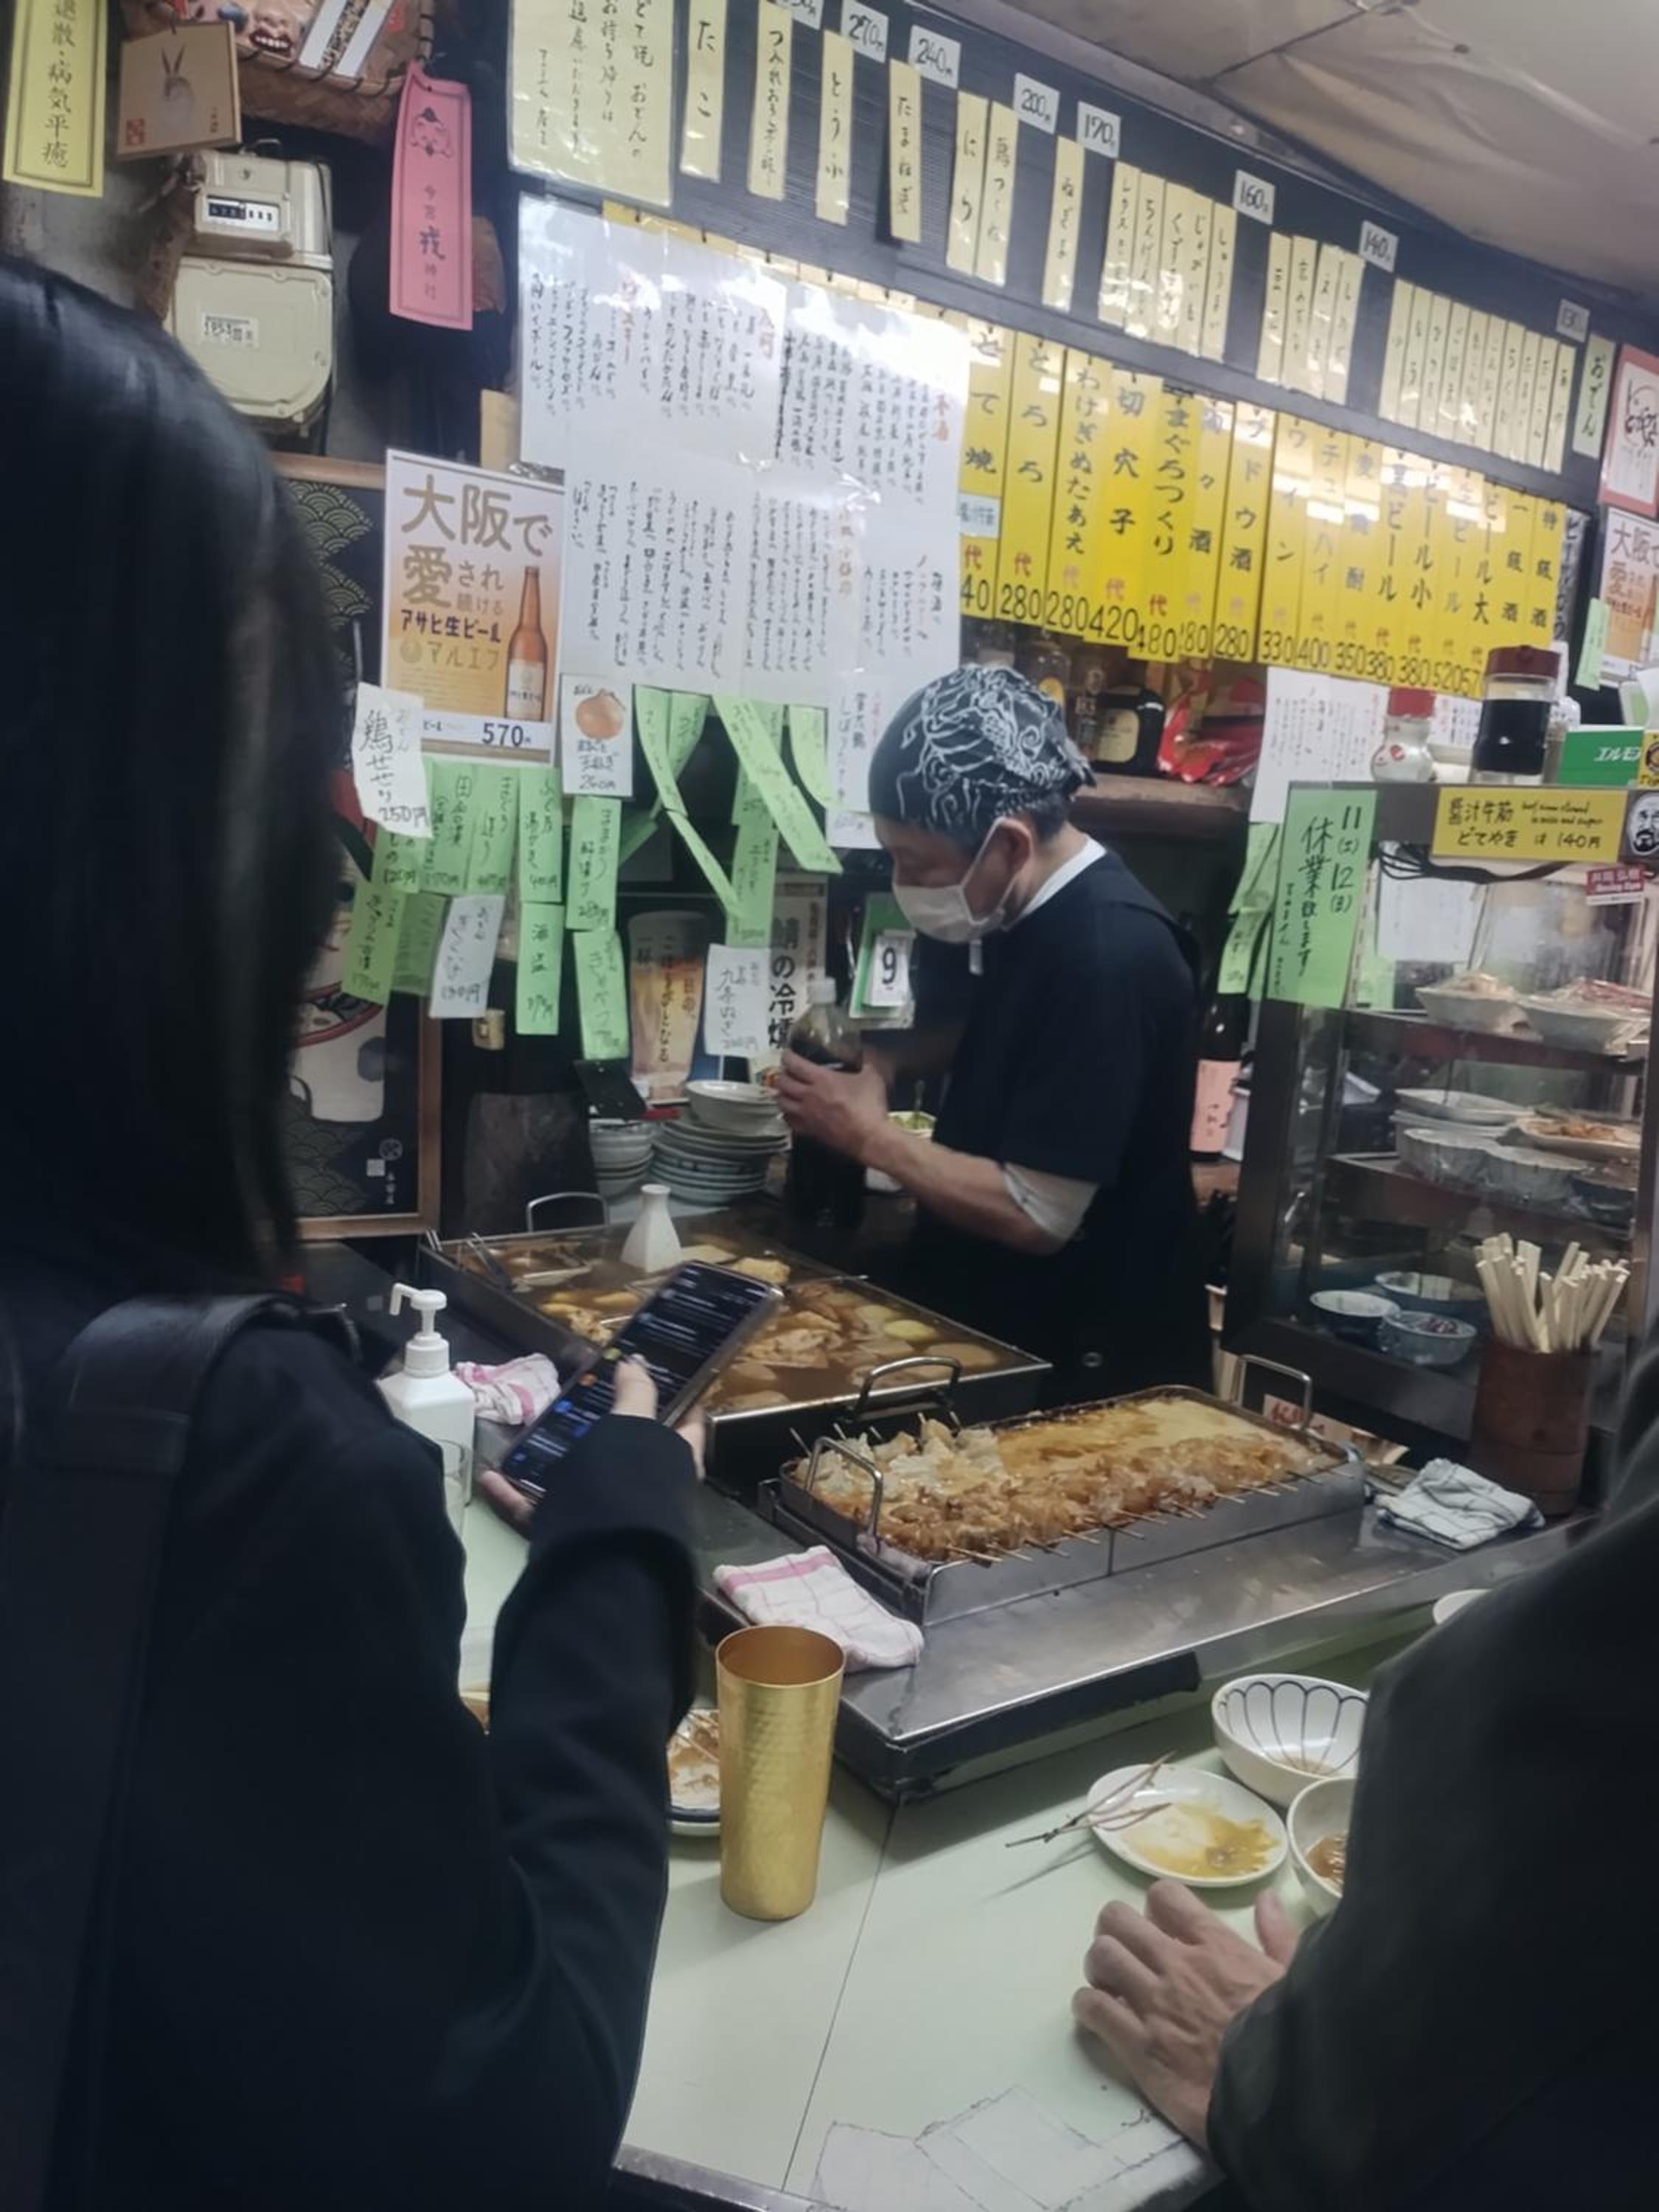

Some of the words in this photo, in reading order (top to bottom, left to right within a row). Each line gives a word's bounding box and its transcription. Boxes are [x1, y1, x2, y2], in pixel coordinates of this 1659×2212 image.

[696, 20, 724, 118] たこ
[1581, 353, 1606, 437] おでん
[1018, 347, 1051, 483] とろろ
[1154, 406, 1191, 555] まぐろつくり
[401, 473, 553, 557] 大阪で
[964, 544, 982, 570] 代
[1410, 474, 1440, 610] ビール小
[403, 543, 505, 624] 愛され
[1015, 552, 1033, 577] 代
[961, 573, 990, 612] 40
[1000, 582, 1042, 620] 280
[1046, 590, 1090, 632] 280
[1150, 594, 1168, 617] 代
[400, 608, 502, 644] アサヒ生ビール
[1088, 603, 1140, 643] 420
[1180, 620, 1208, 654] 80
[1214, 622, 1251, 658] 280
[1341, 806, 1362, 830] 11
[1457, 826, 1519, 847] どてやき
[1331, 863, 1354, 890] 12
[882, 947, 897, 985] 9
